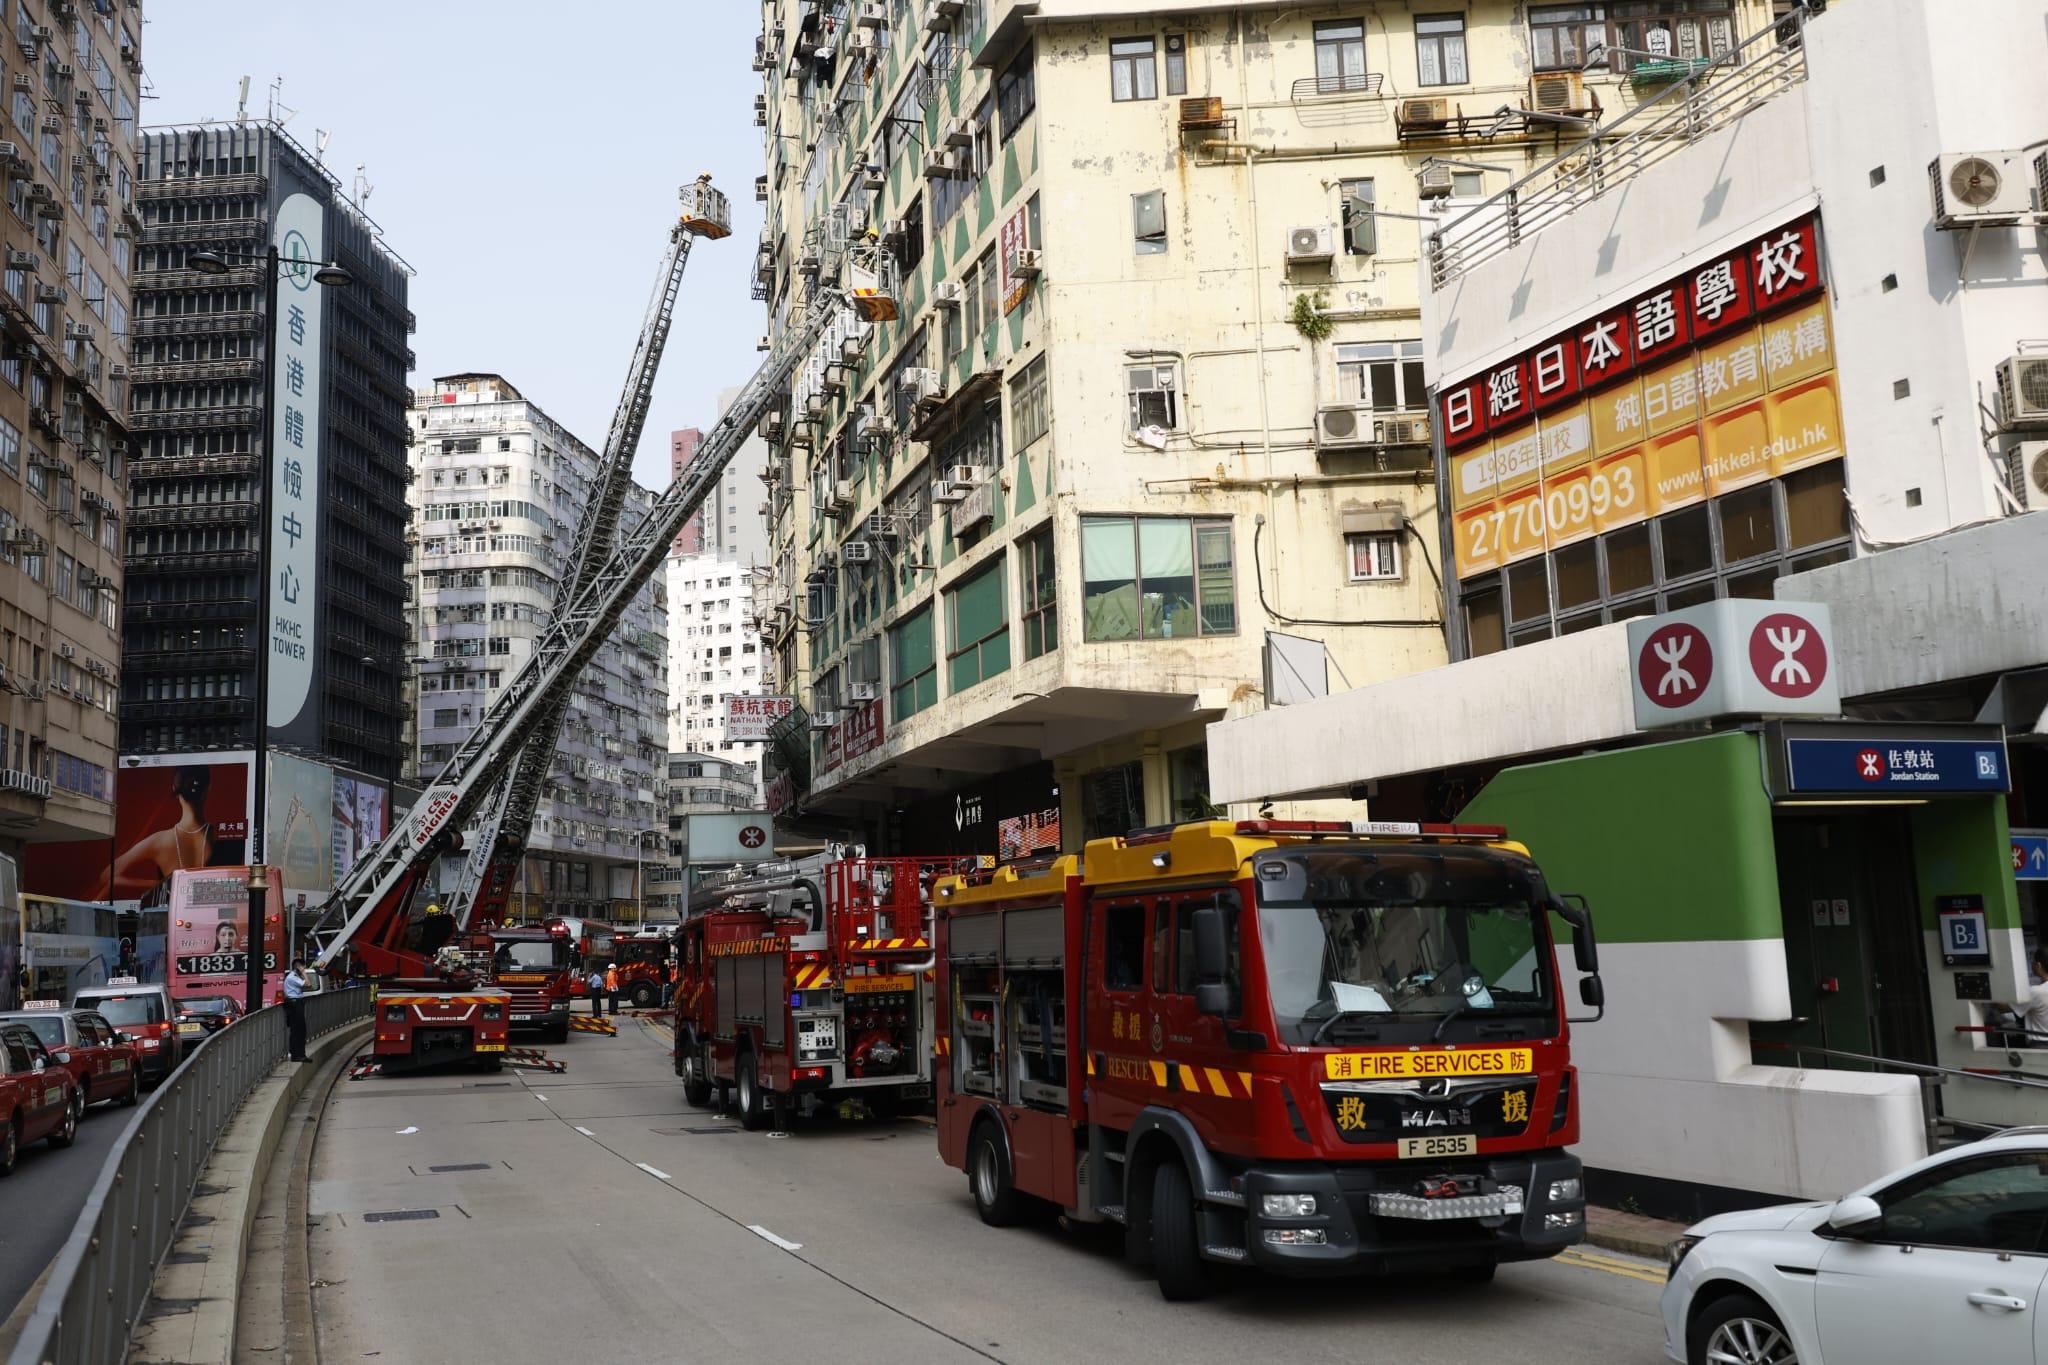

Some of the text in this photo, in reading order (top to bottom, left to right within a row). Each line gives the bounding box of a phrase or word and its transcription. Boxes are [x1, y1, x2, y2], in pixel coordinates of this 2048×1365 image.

[1447, 231, 1805, 433] 日經日本語學校
[1615, 314, 1827, 432] 純日語教育機構
[280, 303, 305, 605] 香港體檢中心
[1477, 427, 1572, 483] 1986年創校
[1658, 424, 1828, 494] www.nikkei.edu.hk
[1470, 465, 1635, 557] 27700993
[275, 615, 302, 639] HKHC
[273, 637, 305, 662] TOWER
[1888, 750, 1935, 768] 佐敦站
[1979, 756, 1997, 775] B2
[1890, 771, 1939, 781] Jordan Station
[415, 792, 459, 844] MAGIRUS
[1371, 824, 1400, 832] FIRE
[478, 828, 494, 867] MAGIRUS
[1954, 924, 1975, 944] B2
[189, 953, 275, 972] 1833 13
[872, 983, 904, 991] SERVICES
[1113, 1012, 1141, 1040] 救援
[1107, 1055, 1150, 1081] RESCUE
[1334, 1051, 1527, 1076] 消 FIRE SERVICES 防
[1336, 1096, 1367, 1131] 救
[1401, 1109, 1470, 1127] MAN
[1502, 1090, 1529, 1124] 援
[1409, 1137, 1467, 1156] F 2535
